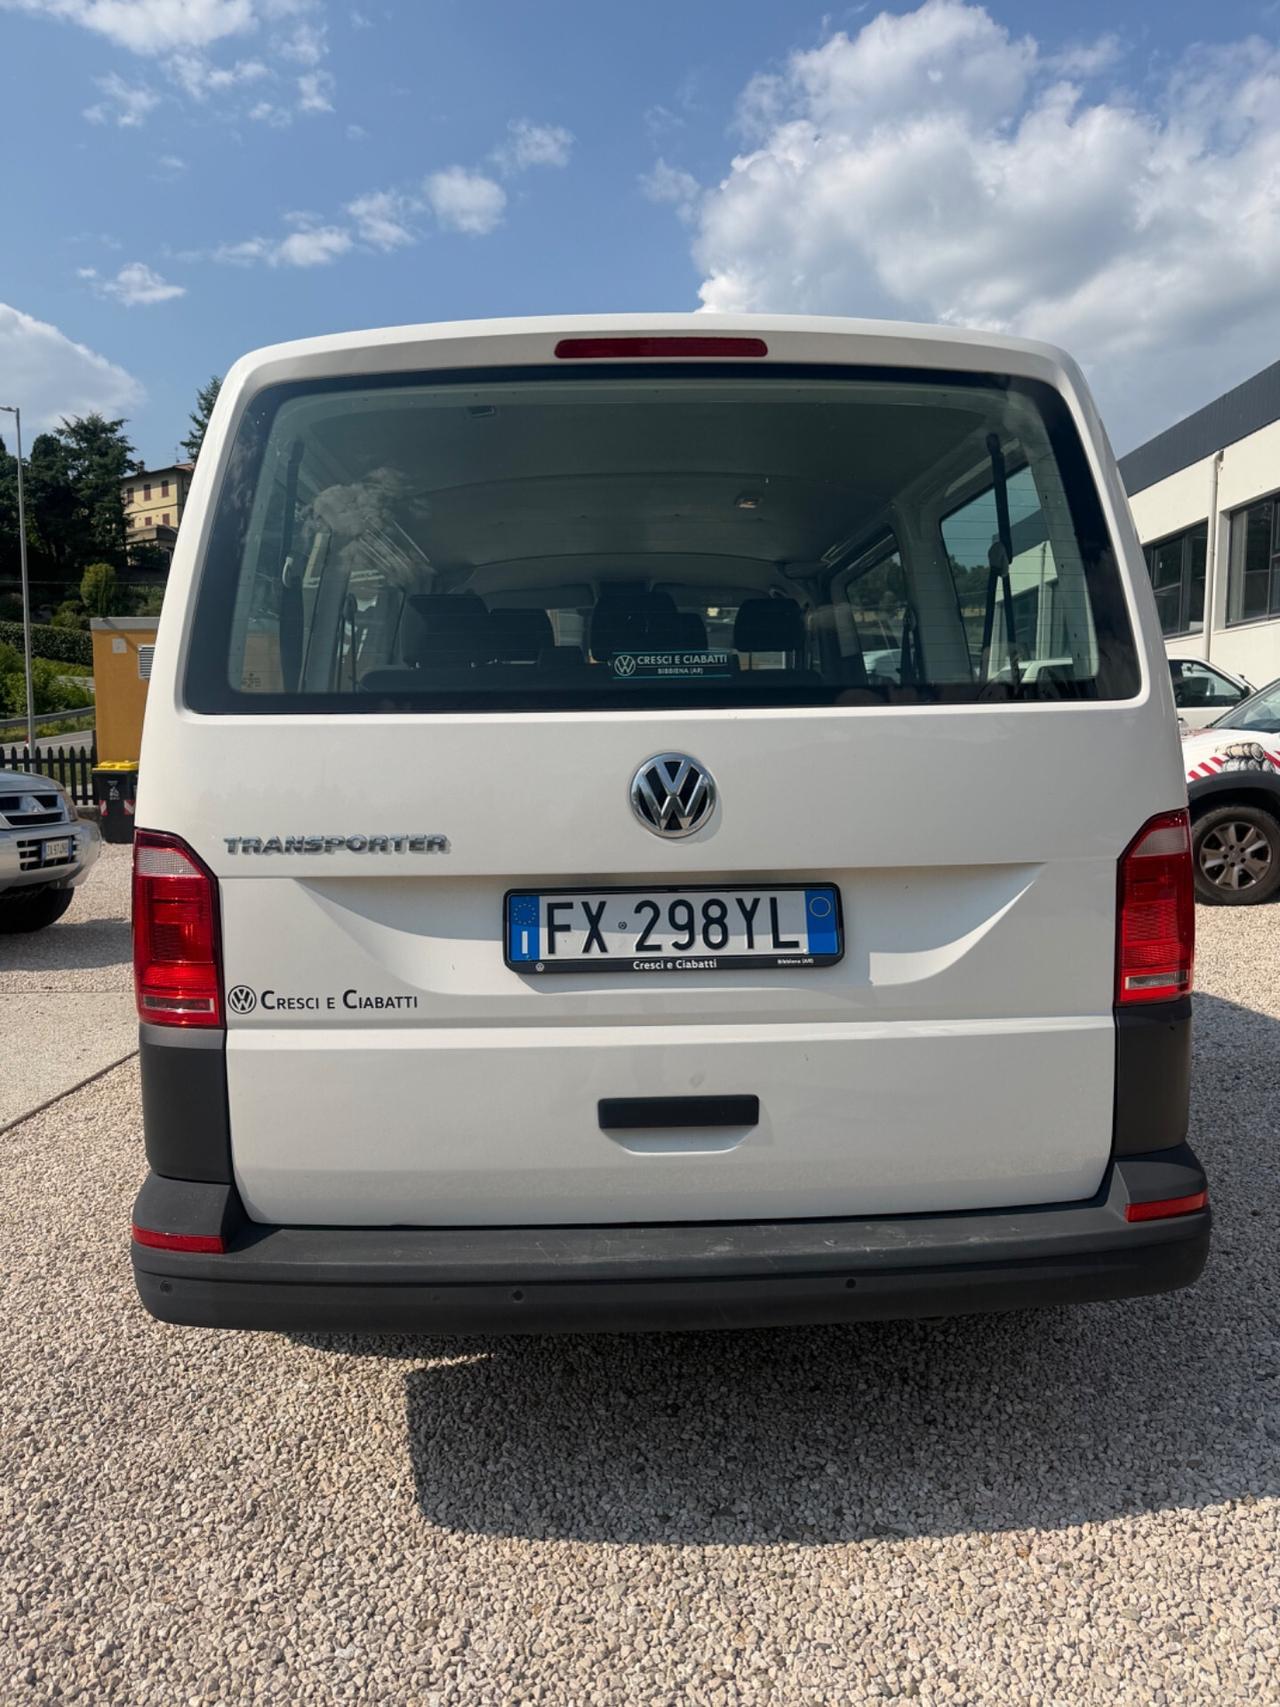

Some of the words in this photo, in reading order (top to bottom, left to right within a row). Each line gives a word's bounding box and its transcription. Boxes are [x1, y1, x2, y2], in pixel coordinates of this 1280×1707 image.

[637, 655, 672, 665] CRESCI
[674, 655, 681, 665] E
[683, 654, 728, 664] CIABATTI
[223, 834, 451, 855] TRANSPORTER
[546, 901, 609, 955] FX
[633, 896, 800, 953] 298YL
[633, 960, 665, 970] Cresci
[666, 962, 673, 970] e
[675, 958, 718, 969] Ciabatti
